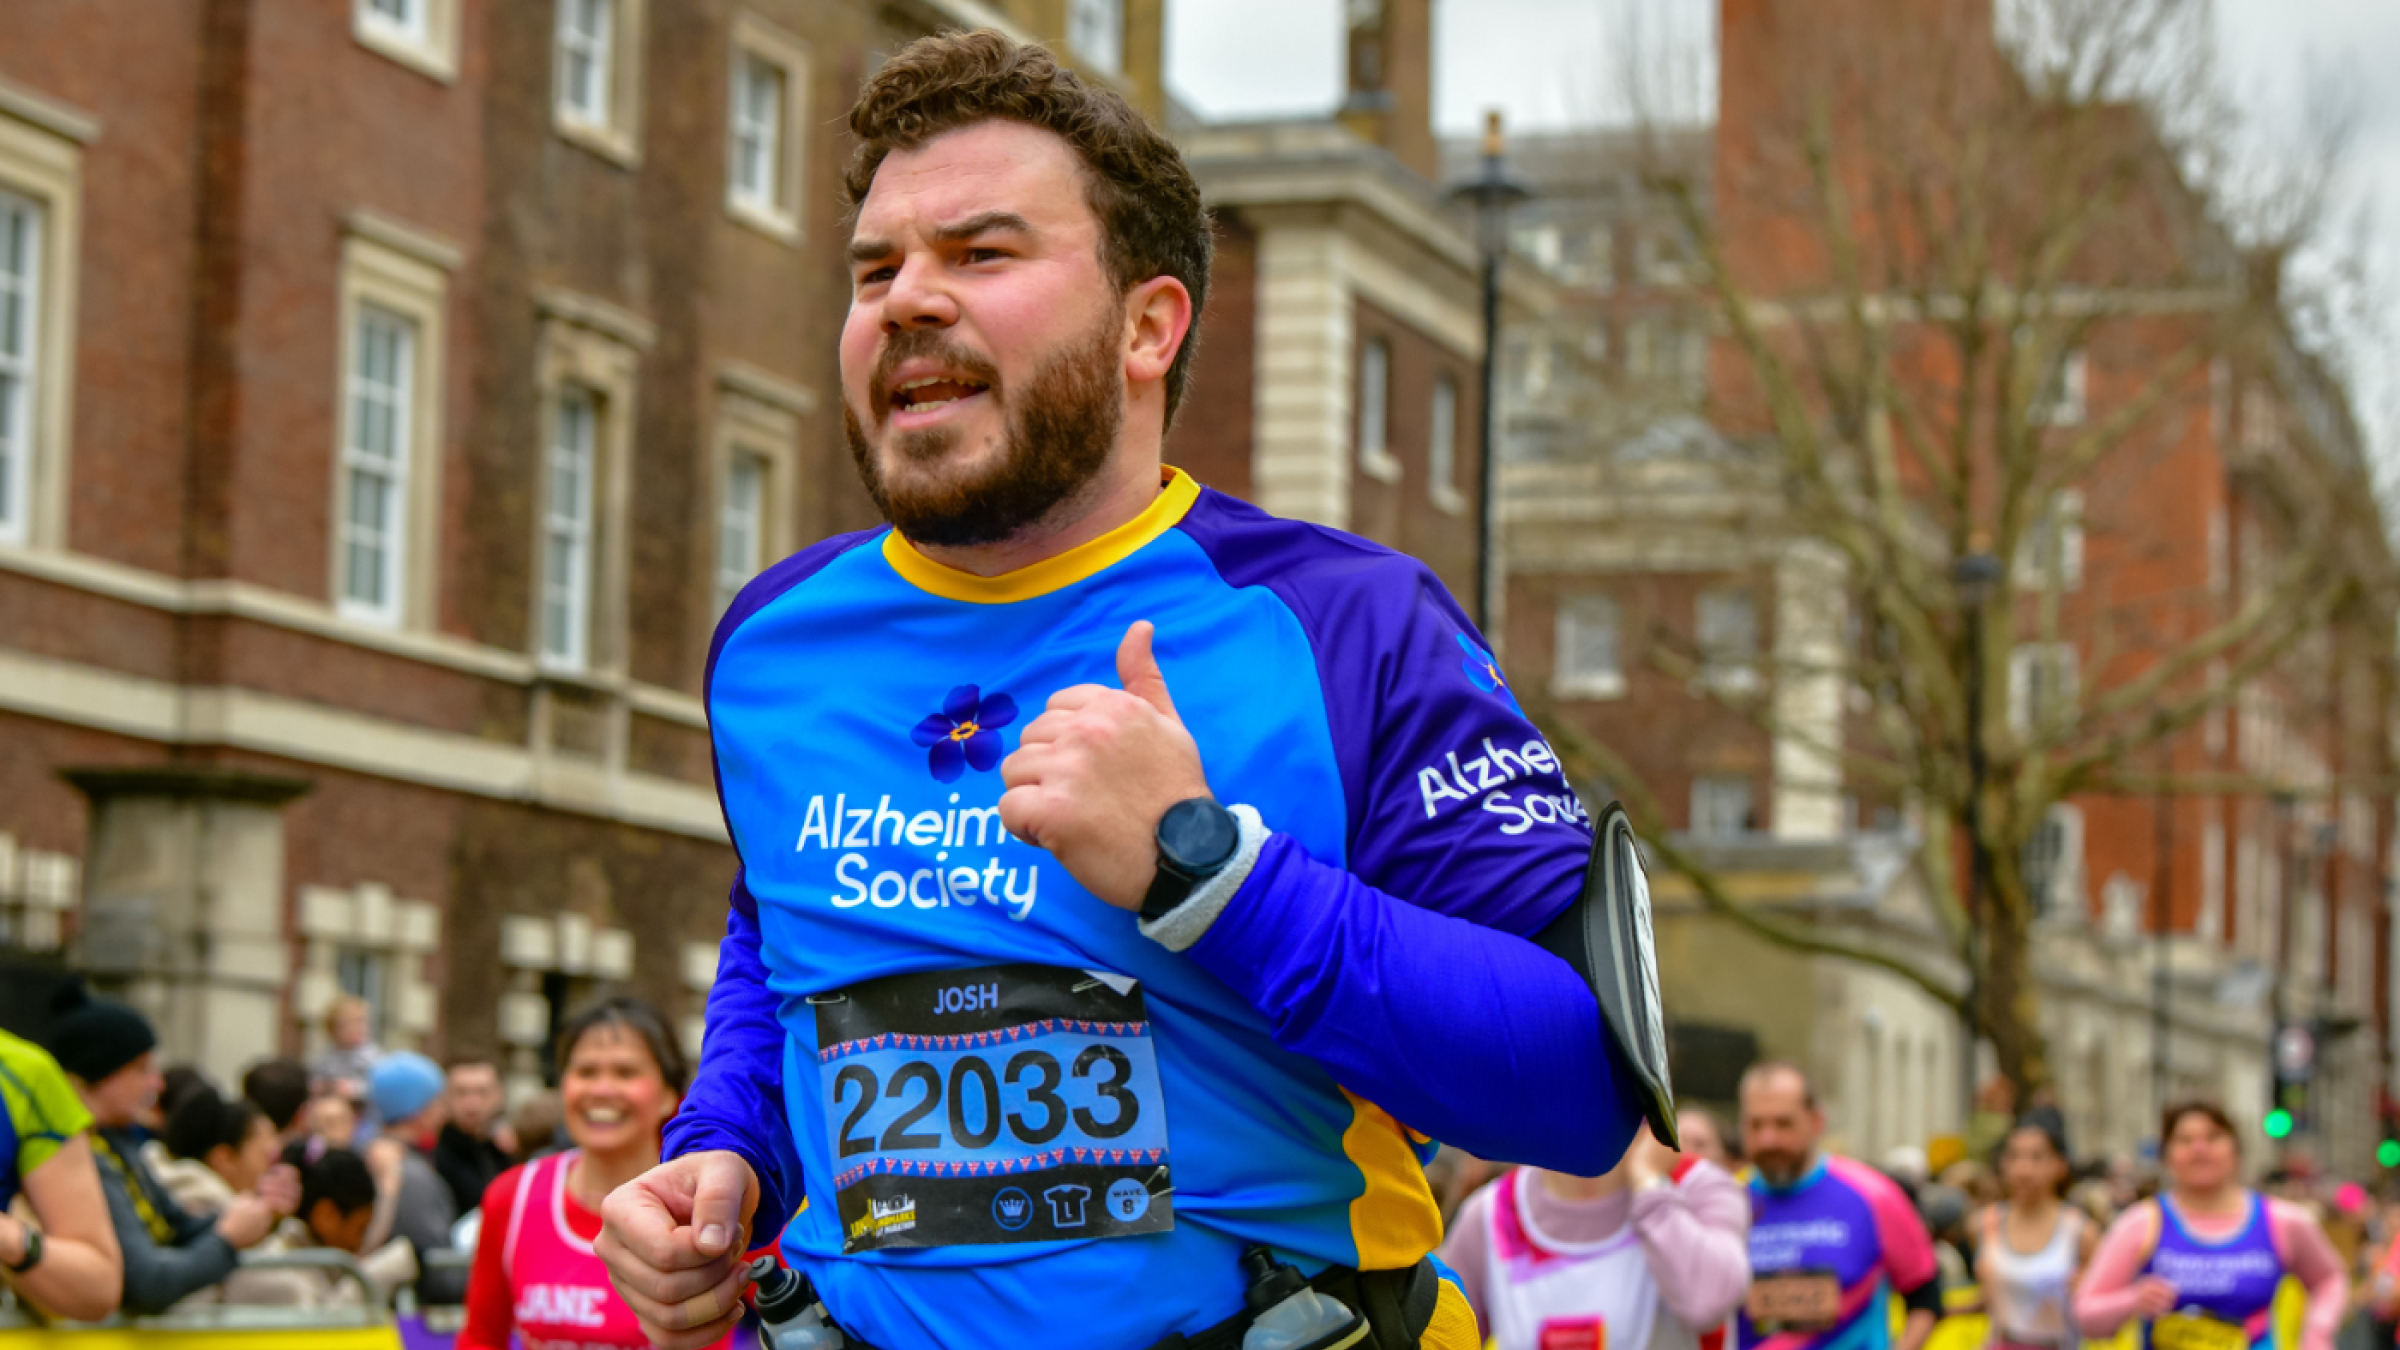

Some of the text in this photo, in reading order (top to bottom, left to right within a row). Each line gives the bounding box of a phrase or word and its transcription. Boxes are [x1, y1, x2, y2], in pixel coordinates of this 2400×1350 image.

[796, 792, 1021, 852] Alzheim
[830, 851, 1038, 922] Society
[933, 983, 999, 1015] JOSH
[833, 1044, 1140, 1159] 22033
[514, 1284, 608, 1328] JANE
